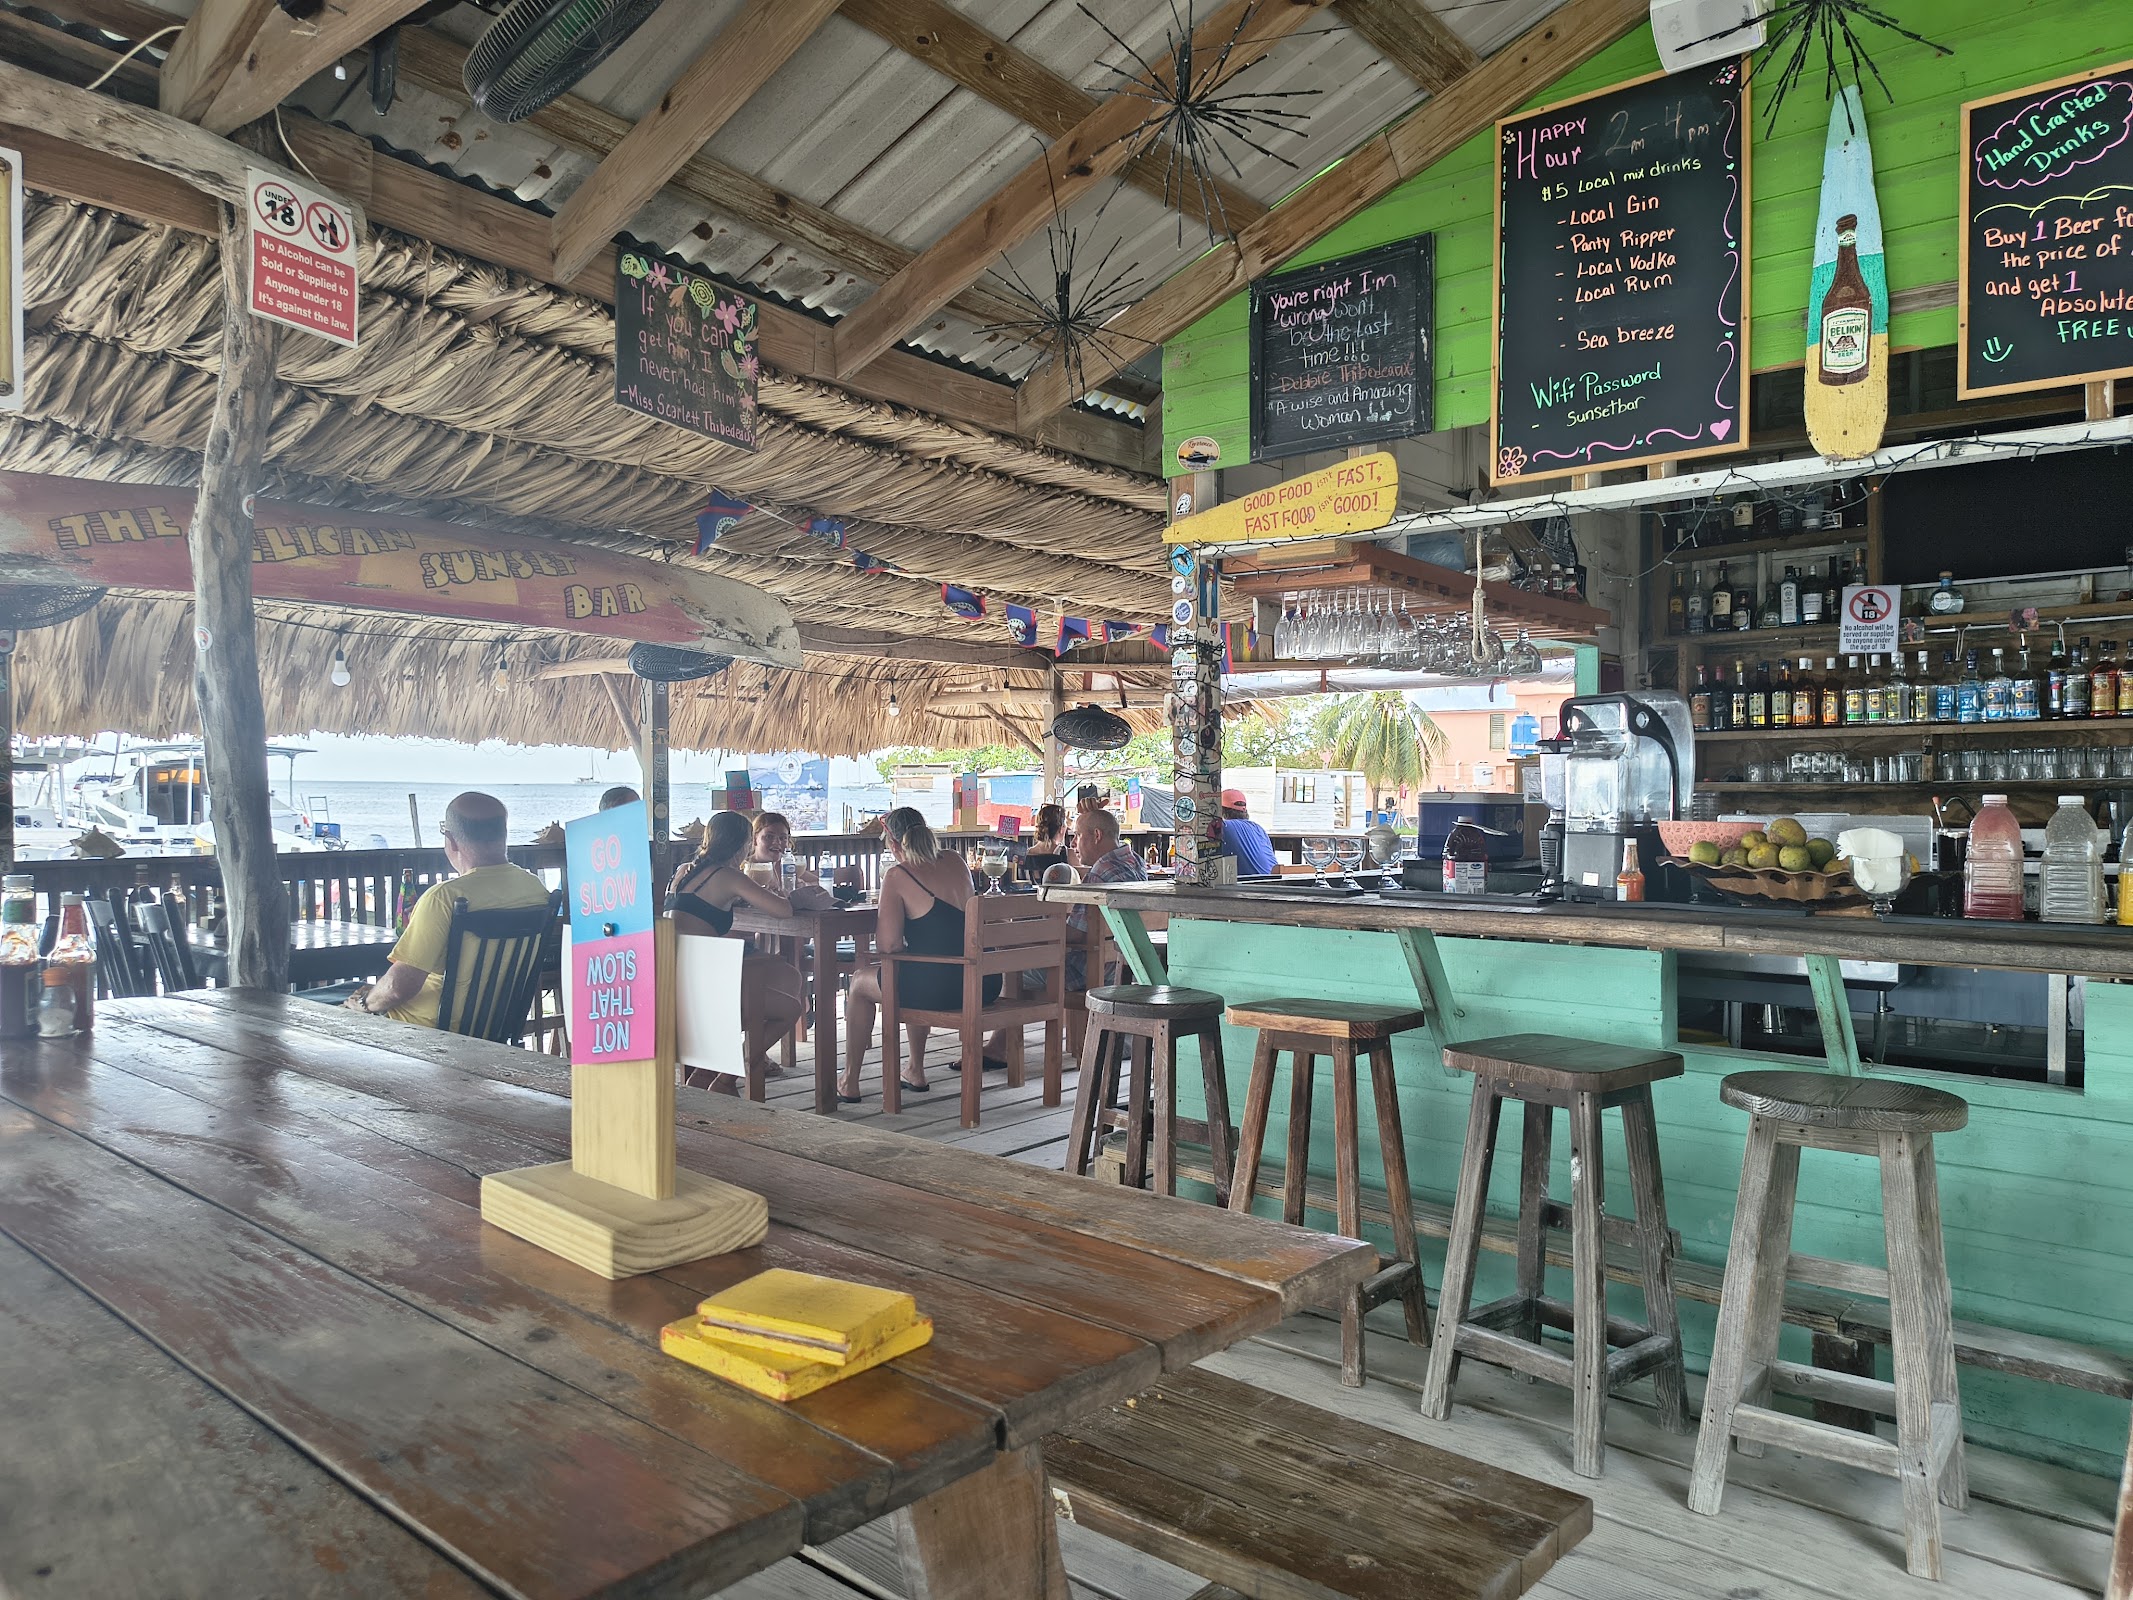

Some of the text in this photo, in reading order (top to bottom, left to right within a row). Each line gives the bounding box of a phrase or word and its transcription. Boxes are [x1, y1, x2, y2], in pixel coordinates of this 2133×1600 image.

[1985, 85, 2107, 171] Hand Crafted
[2024, 120, 2110, 172] Drinks
[1541, 157, 1702, 202] $5 Local mix drinks
[264, 189, 294, 207] UNDER
[264, 199, 296, 227] 18
[1569, 194, 1660, 227] Local Gin
[1570, 227, 1676, 254] Panty Ripper
[1983, 228, 2027, 249] Buy
[2031, 220, 2048, 242] 1
[2054, 217, 2105, 240] Beer
[2000, 233, 2122, 269] the price of
[261, 237, 346, 279] No Alcohol can be
[261, 255, 349, 297] Sold or Supplied to
[1576, 251, 1677, 279] Local Vodka
[264, 275, 343, 312] Anyone under 18
[1314, 277, 1352, 313] right
[1360, 270, 1397, 294] I'm
[1575, 273, 1673, 304] Local Rum
[1985, 270, 2083, 300] and get 1
[258, 291, 350, 332] It's against the law.
[665, 313, 729, 349] you can
[1577, 323, 1675, 351] Sea breeze
[1830, 324, 1863, 337] BELIKIN
[2057, 318, 2119, 343] FREE
[638, 330, 662, 354] get
[701, 350, 714, 374] I
[640, 356, 678, 385] never
[684, 373, 706, 398] had
[1579, 361, 1662, 401] Password
[657, 393, 700, 427] Scarlett
[1291, 395, 1323, 412] wise
[1328, 387, 1349, 404] and
[1243, 460, 1382, 514] GOOD FOOD isn't FAST,
[1244, 491, 1379, 534] FAST FOOD isn't GOOD!
[49, 506, 416, 563] THE LICAN
[420, 550, 577, 589] SUNSET
[563, 583, 647, 619] BAR
[1863, 610, 1876, 619] 18
[1870, 630, 1895, 639] supplied
[1875, 623, 1886, 631] will
[590, 834, 622, 873] GO
[580, 872, 638, 917] SLOW
[586, 949, 638, 988] SLOW
[589, 985, 635, 1020] THAT
[592, 1020, 630, 1054] NOT
